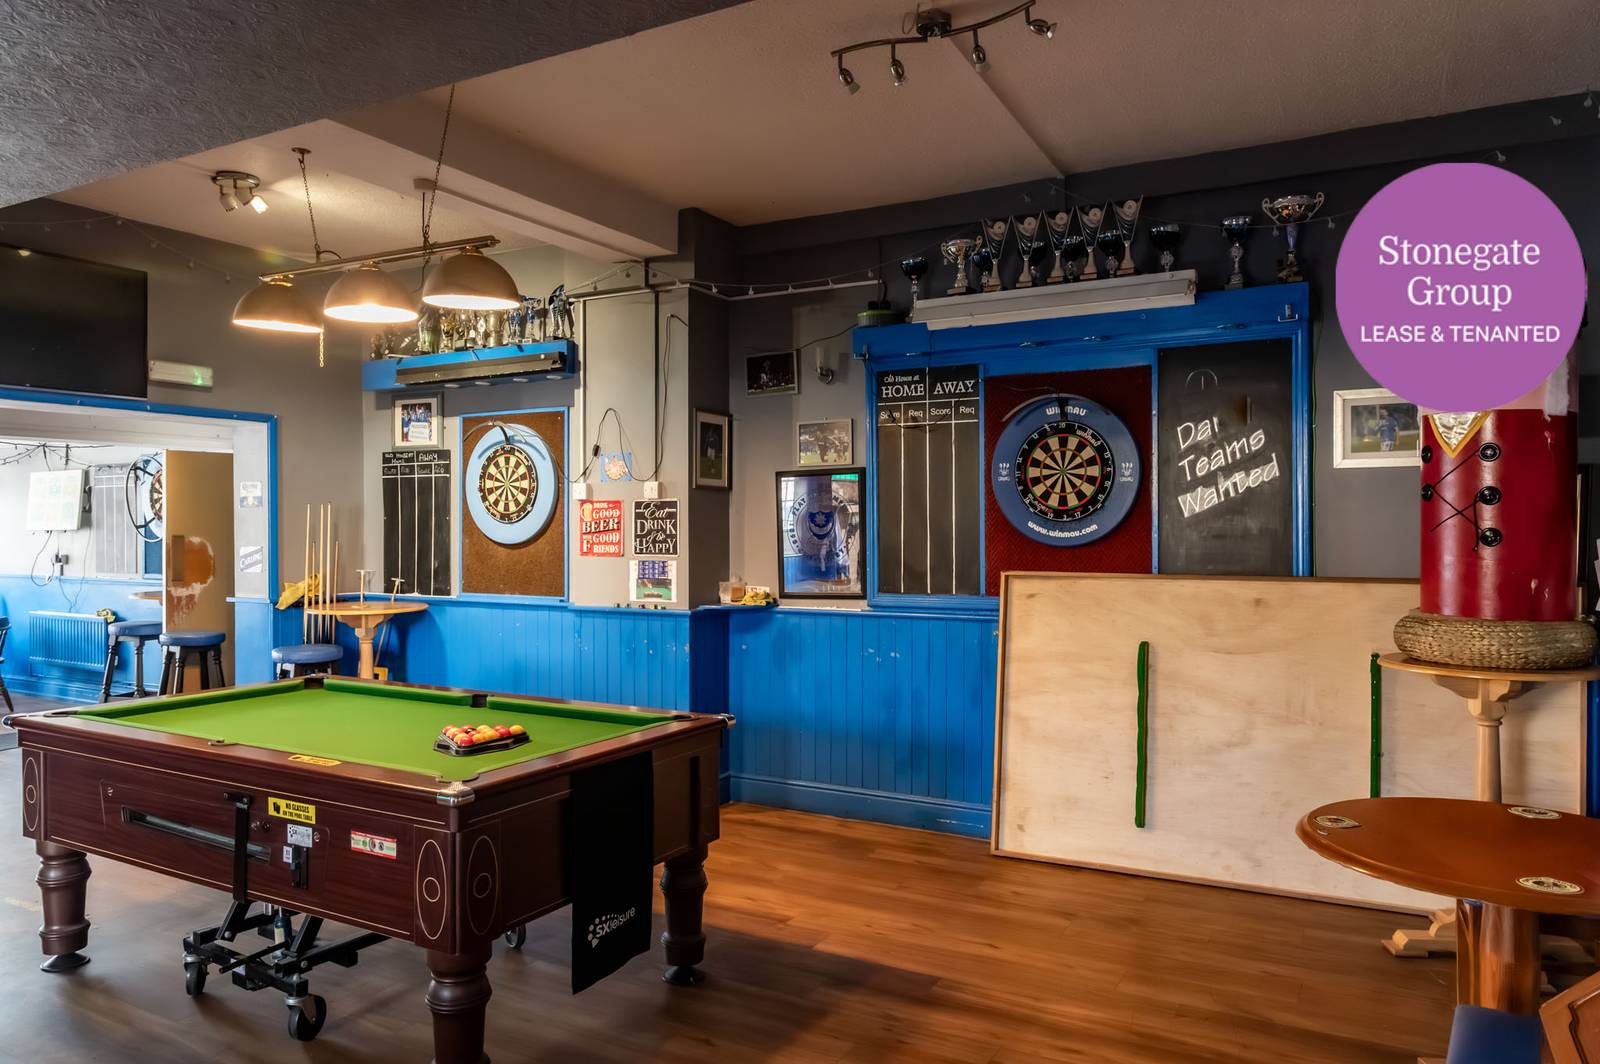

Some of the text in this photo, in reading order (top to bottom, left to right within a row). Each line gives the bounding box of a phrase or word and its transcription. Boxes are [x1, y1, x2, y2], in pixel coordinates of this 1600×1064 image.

[884, 374, 894, 382] Old
[882, 384, 925, 398] HOME
[933, 380, 976, 394] AWAY
[880, 411, 900, 419] Scre
[908, 410, 924, 418] Req
[930, 408, 952, 416] Score
[960, 406, 975, 414] Req
[418, 452, 438, 462] AWAY
[1178, 429, 1265, 481] Teams
[1178, 452, 1280, 518] Wanted
[593, 509, 620, 518] GOOD
[641, 502, 670, 518] Eat
[582, 518, 620, 533] BEER
[637, 520, 676, 534] DRINK
[593, 532, 620, 543] GOOD
[636, 538, 676, 553] HAPPY
[286, 802, 291, 810] NO
